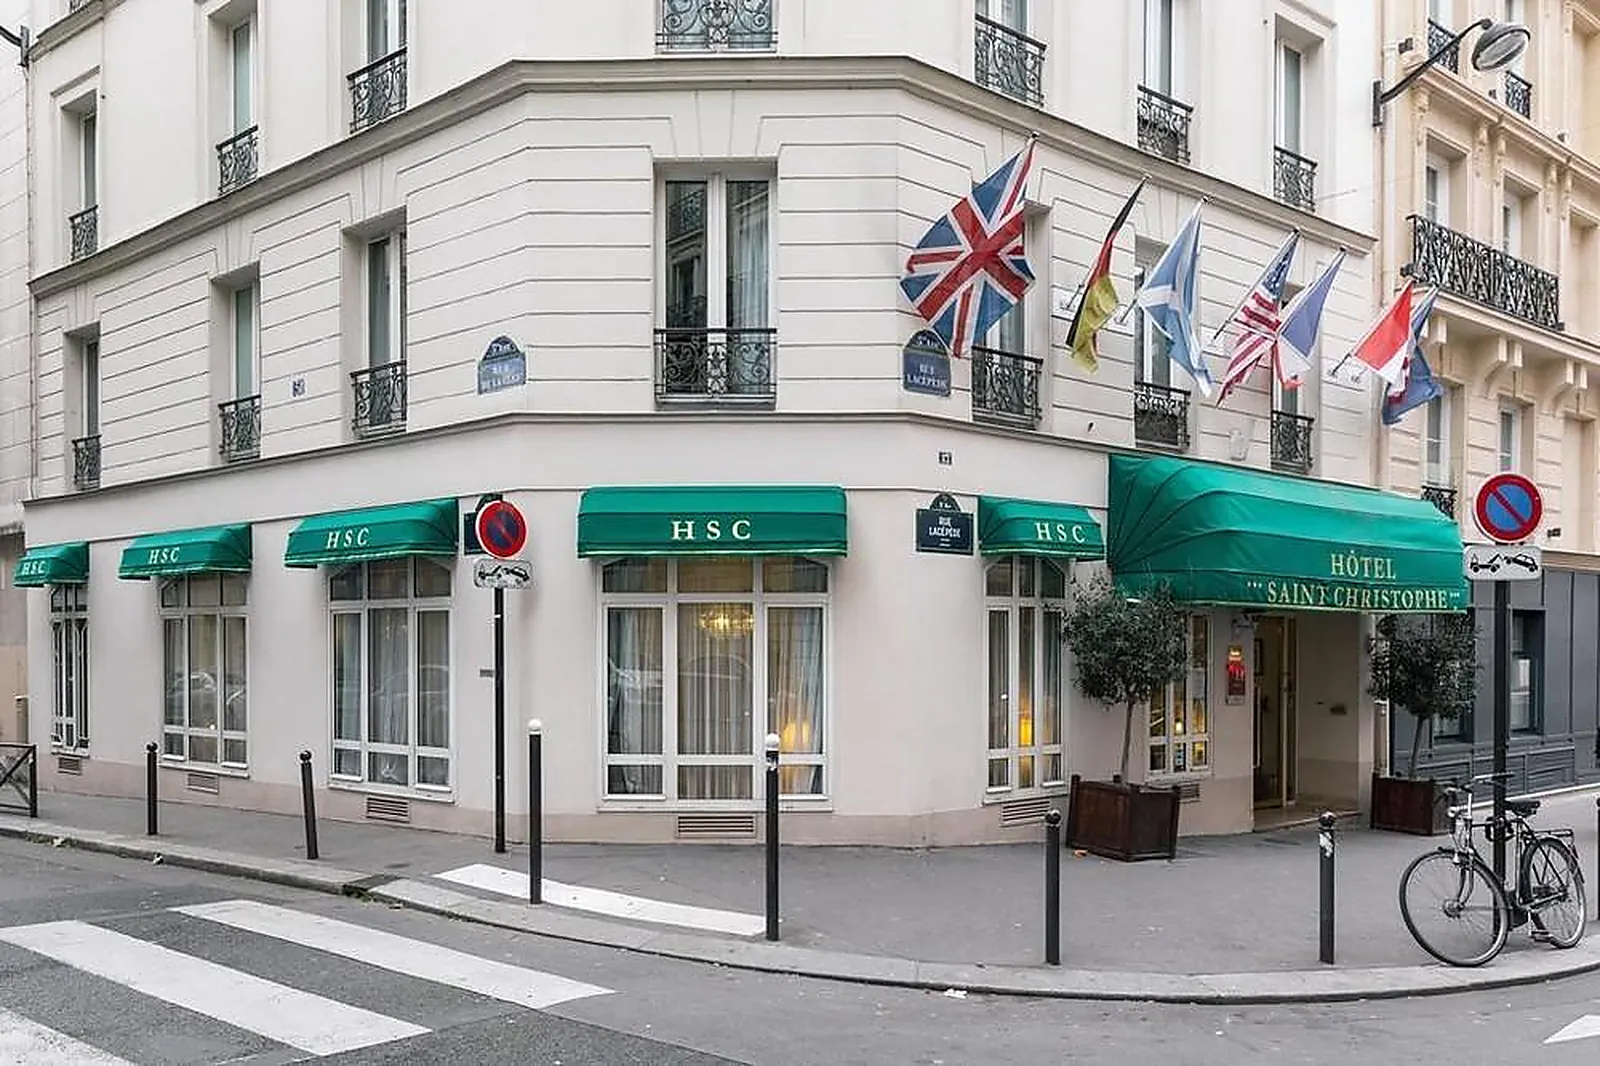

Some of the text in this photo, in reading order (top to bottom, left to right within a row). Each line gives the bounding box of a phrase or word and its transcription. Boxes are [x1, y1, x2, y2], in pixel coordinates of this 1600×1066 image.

[671, 519, 752, 541] HSC
[938, 516, 951, 526] RUE
[326, 527, 370, 549] HSC
[1034, 522, 1087, 543] HSC
[149, 547, 180, 564] HSC
[21, 560, 46, 576] HSC
[1267, 581, 1448, 609] SAINT CHRISTOPHE
